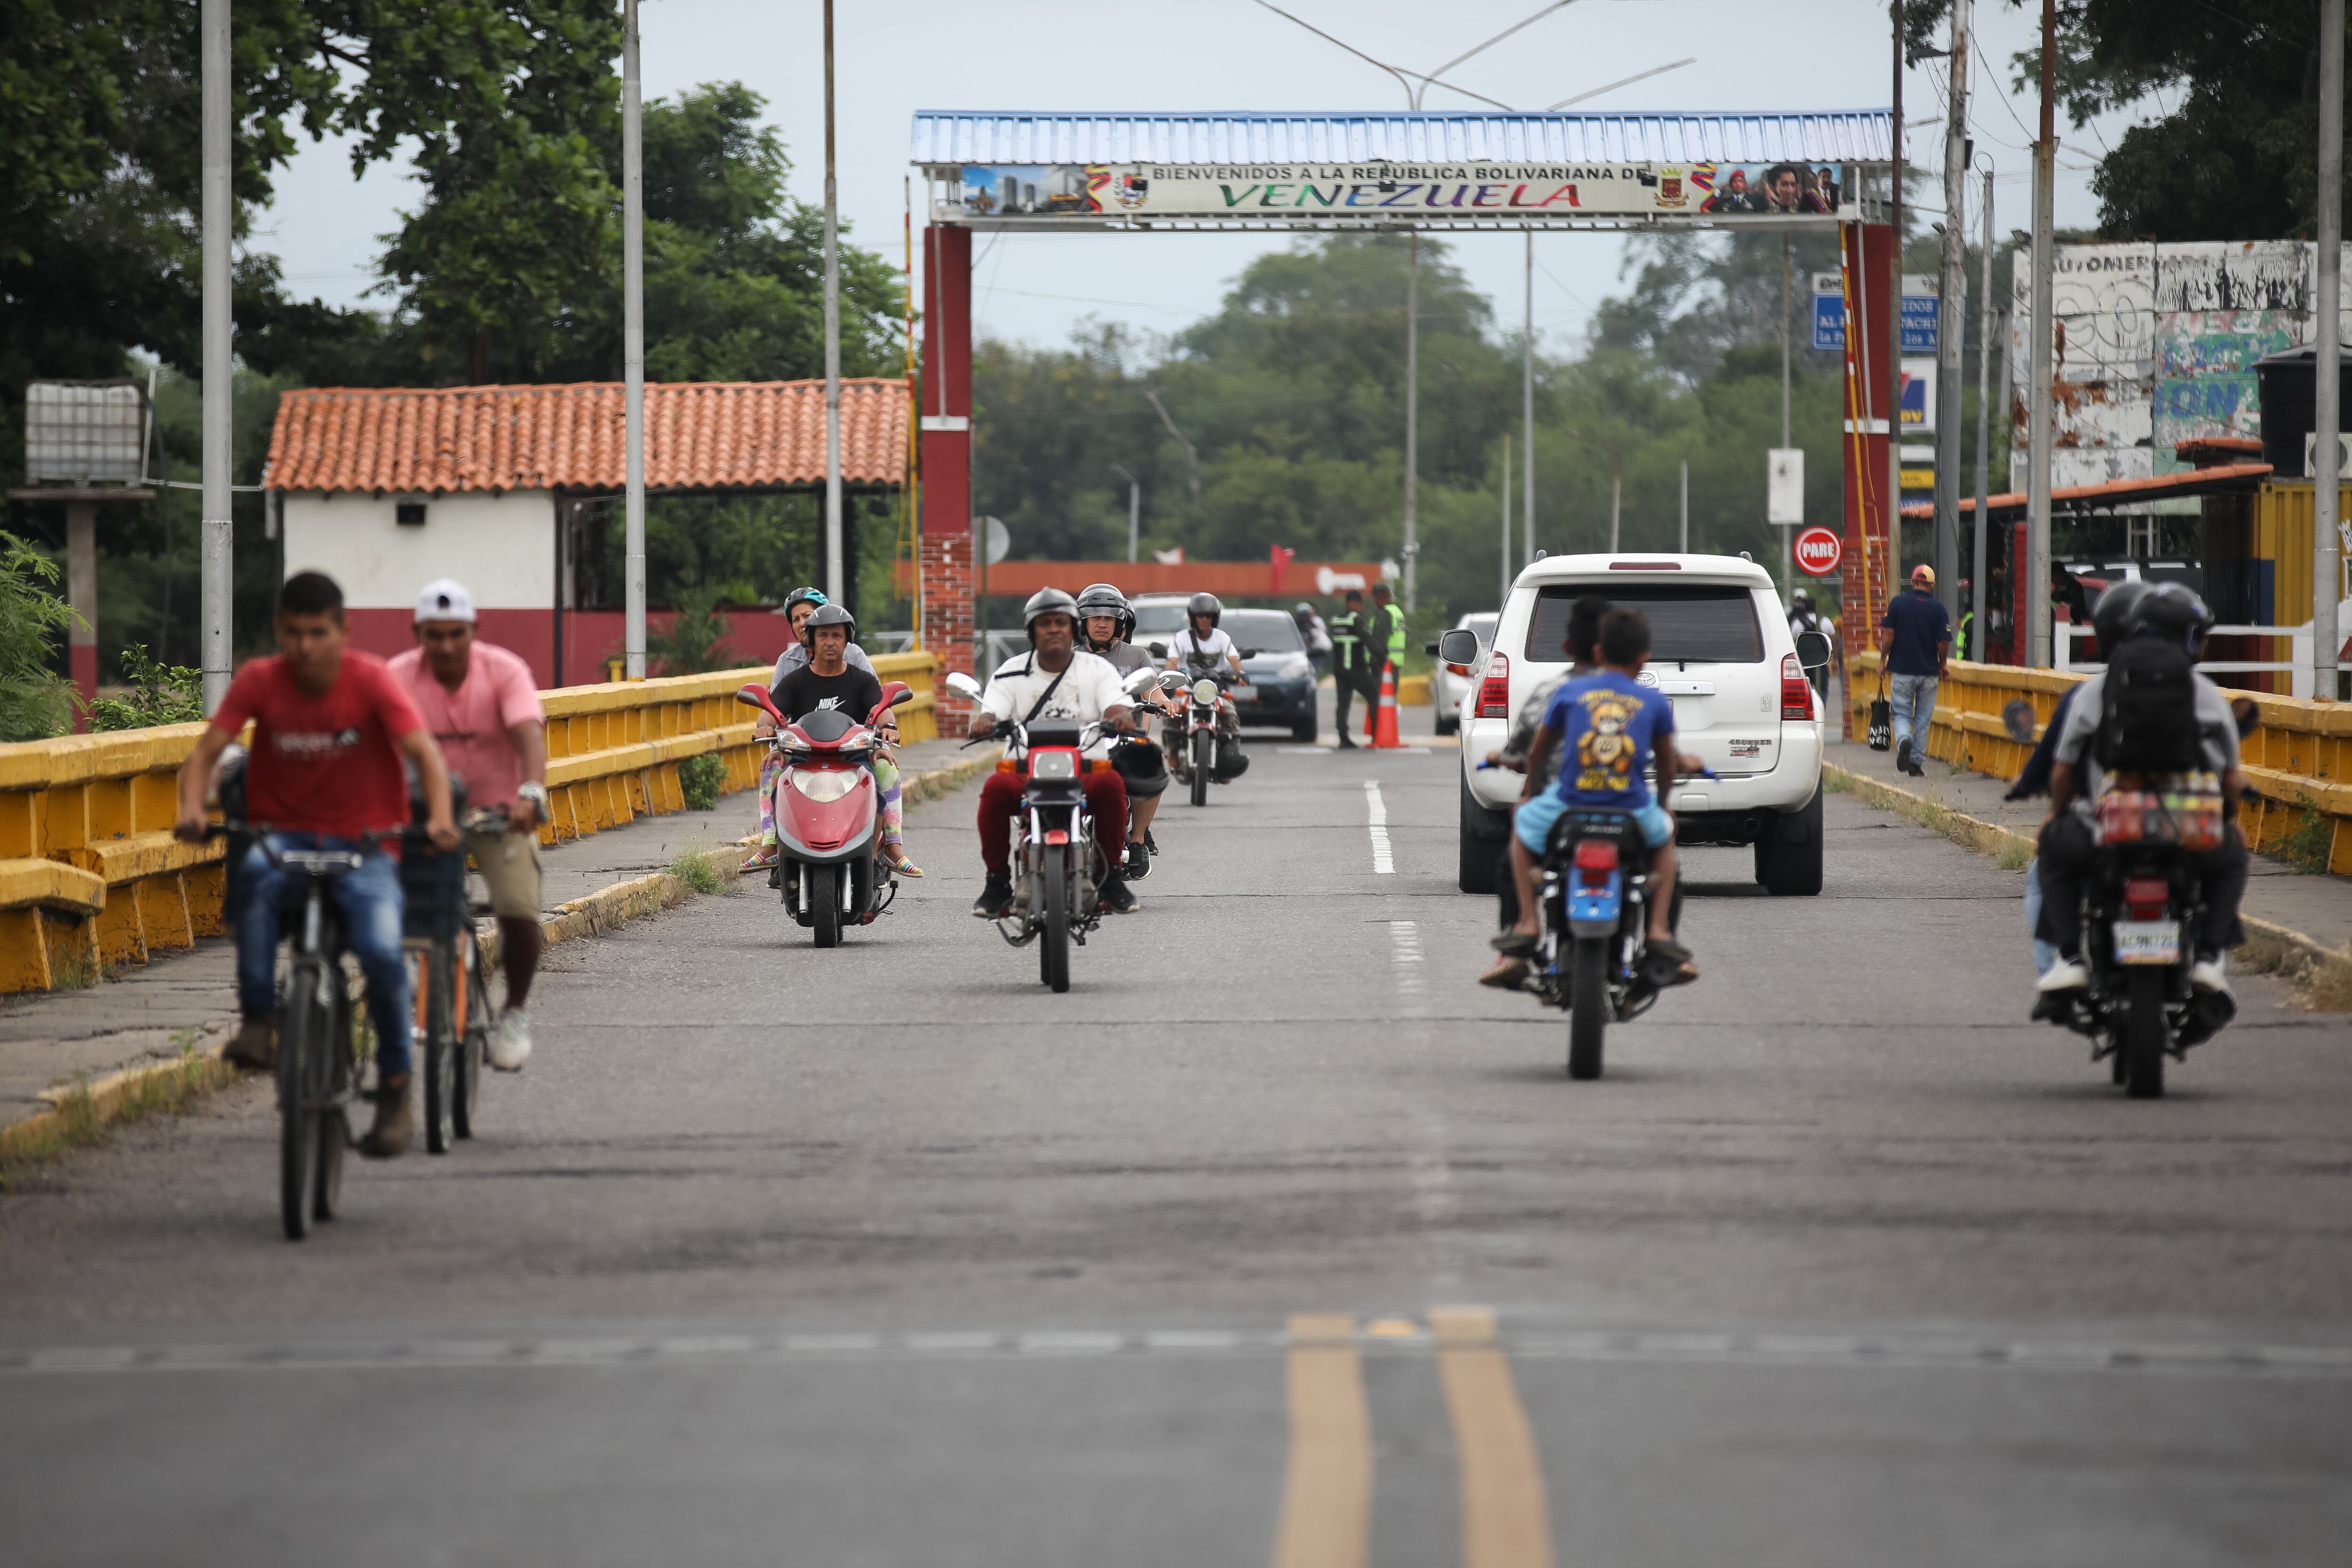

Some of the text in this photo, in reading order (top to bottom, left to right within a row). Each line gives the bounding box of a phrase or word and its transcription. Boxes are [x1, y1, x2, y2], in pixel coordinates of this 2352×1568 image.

[1154, 168, 1292, 179] BIENVENIDOS
[1301, 168, 1313, 179] A
[1320, 168, 1344, 179] LA
[1353, 168, 1468, 179] REPUBLICA
[1476, 167, 1614, 180] BOLIVARIANA
[1218, 183, 1582, 207] VENEZUELA
[1803, 541, 1835, 558] PARE
[818, 696, 839, 710] NIKE
